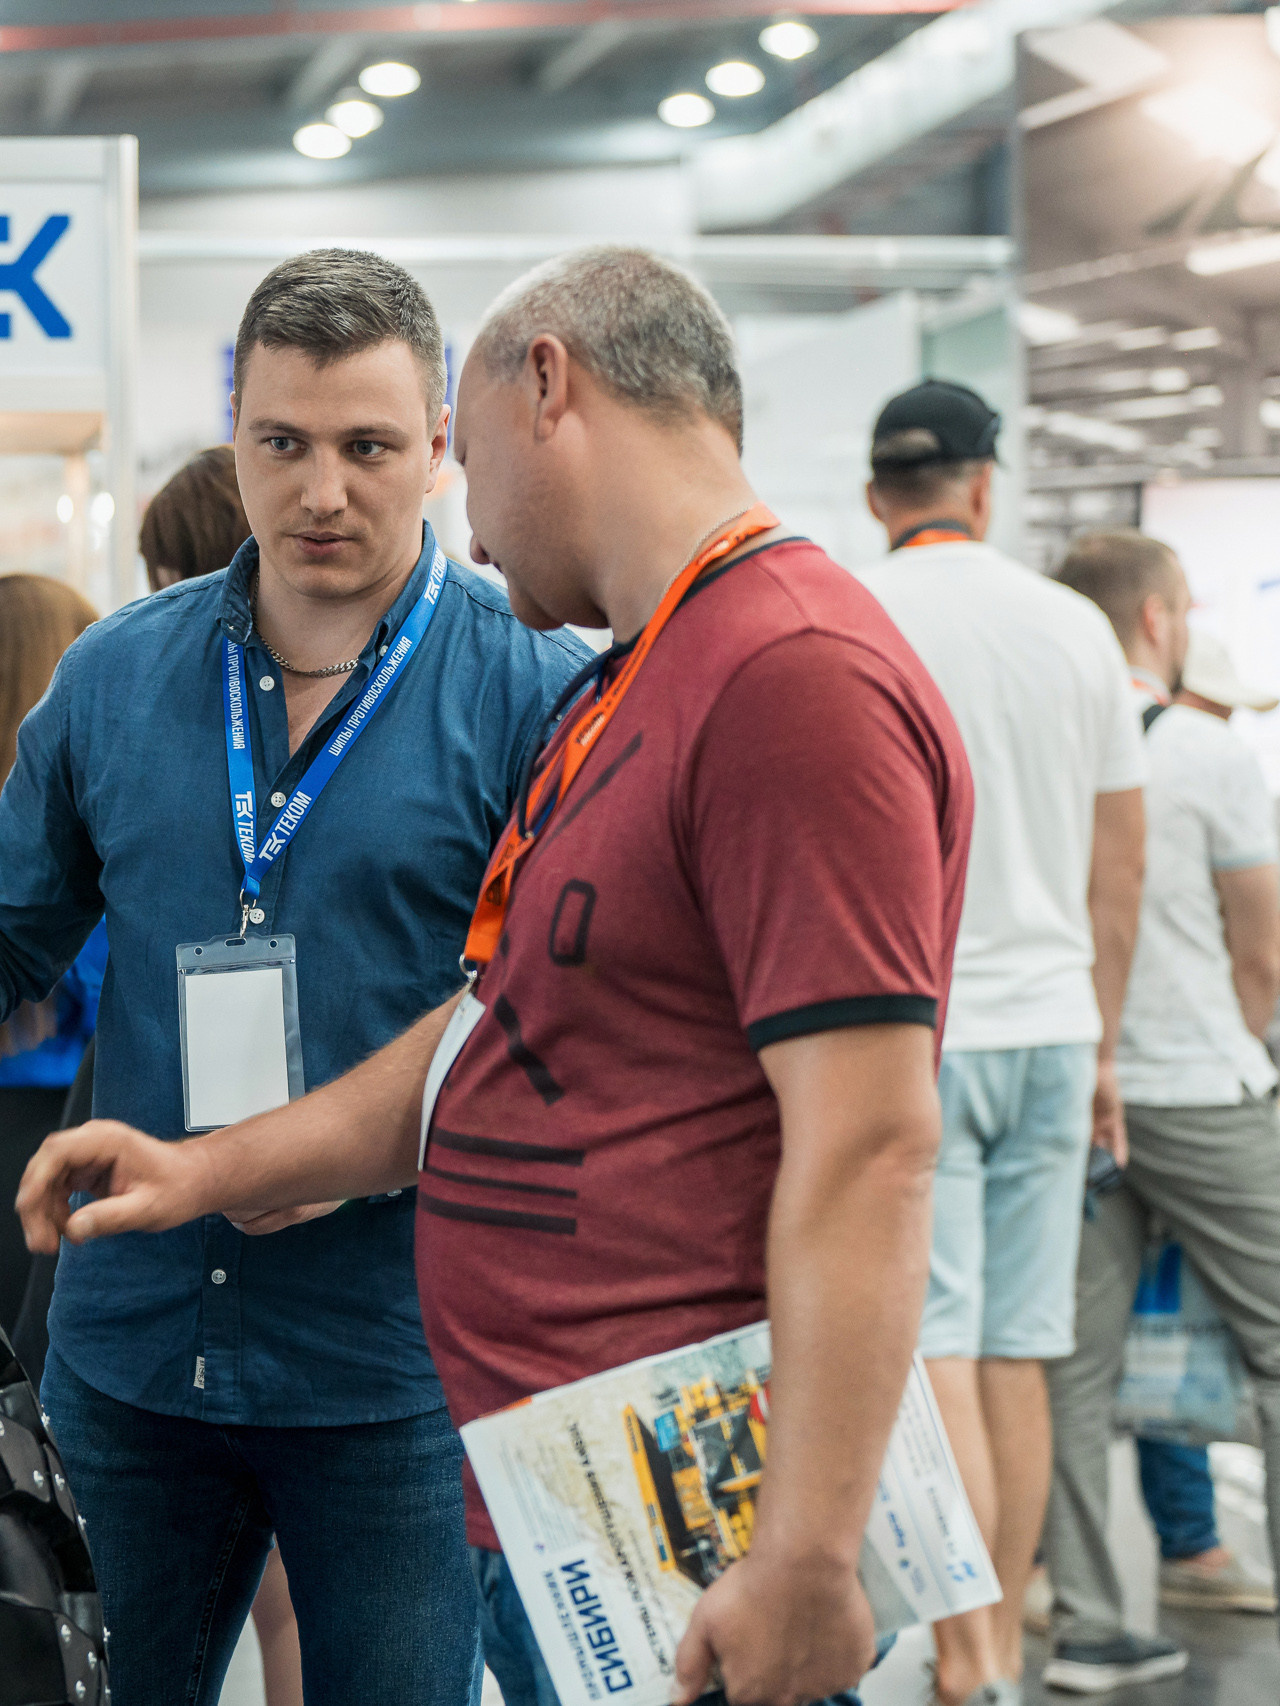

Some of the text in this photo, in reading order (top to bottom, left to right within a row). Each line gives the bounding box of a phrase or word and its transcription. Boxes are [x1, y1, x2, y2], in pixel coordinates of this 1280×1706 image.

[228, 654, 246, 750] ПРОТИВОСКОЛЬЖЕНИЯ
[328, 635, 413, 757] ШИПЫ ПРОТИВОСКОЛЬЖЕНИЯ
[560, 1558, 633, 1694] СИБИРИ
